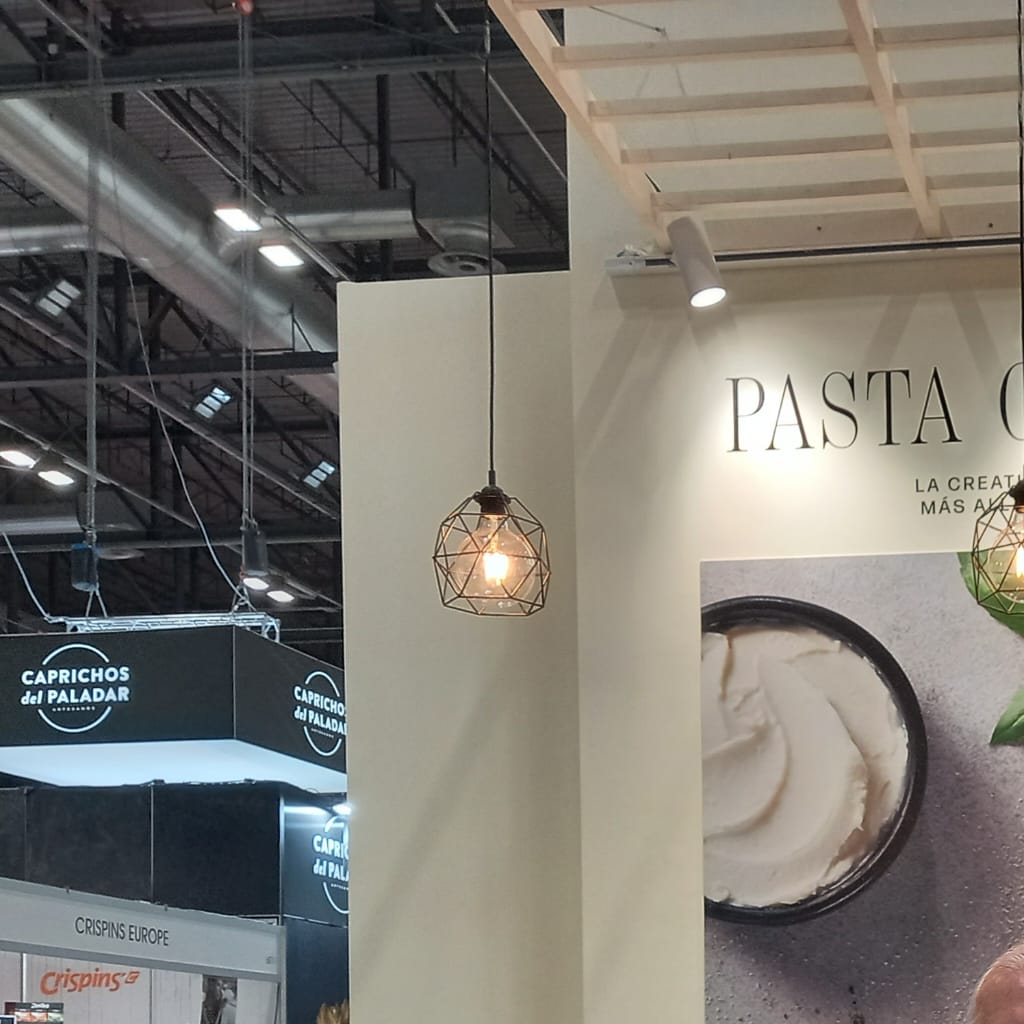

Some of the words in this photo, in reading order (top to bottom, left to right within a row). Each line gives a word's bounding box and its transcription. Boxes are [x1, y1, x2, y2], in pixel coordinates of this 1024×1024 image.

[727, 367, 962, 452] PASTA
[915, 478, 939, 493] LA
[921, 495, 965, 515] MÁS
[21, 666, 130, 686] CAPRICHOS
[20, 690, 43, 705] del
[47, 686, 130, 704] PALADAR
[294, 705, 307, 721] del
[75, 916, 126, 941] CRISPINS
[128, 924, 169, 947] EUROPE
[41, 967, 121, 995] Crispins
